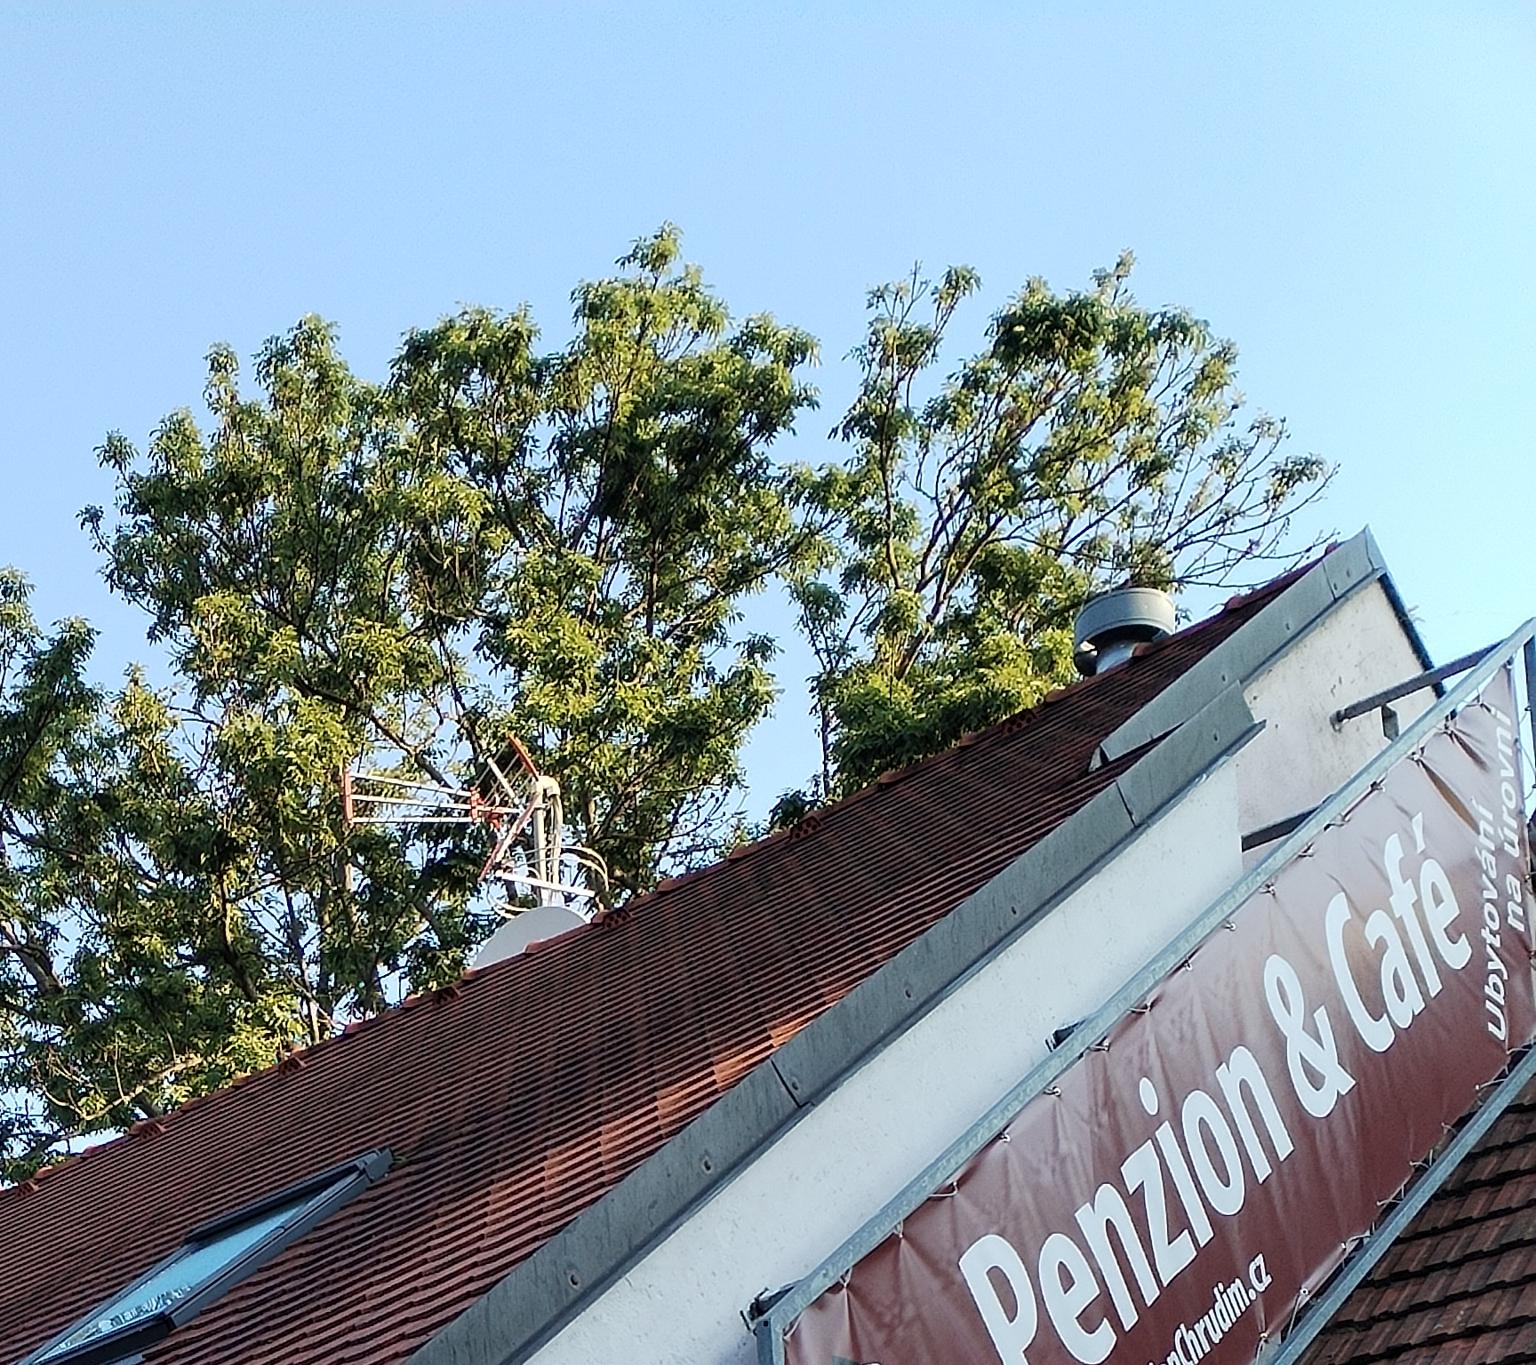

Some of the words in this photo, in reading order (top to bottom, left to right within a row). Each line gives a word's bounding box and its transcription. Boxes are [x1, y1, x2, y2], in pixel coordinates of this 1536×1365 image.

[1492, 709, 1521, 858] úrovni
[1263, 953, 1357, 1118] &
[1325, 811, 1473, 1053] Café
[1471, 798, 1509, 1041] Ubytování
[1505, 874, 1525, 932] na
